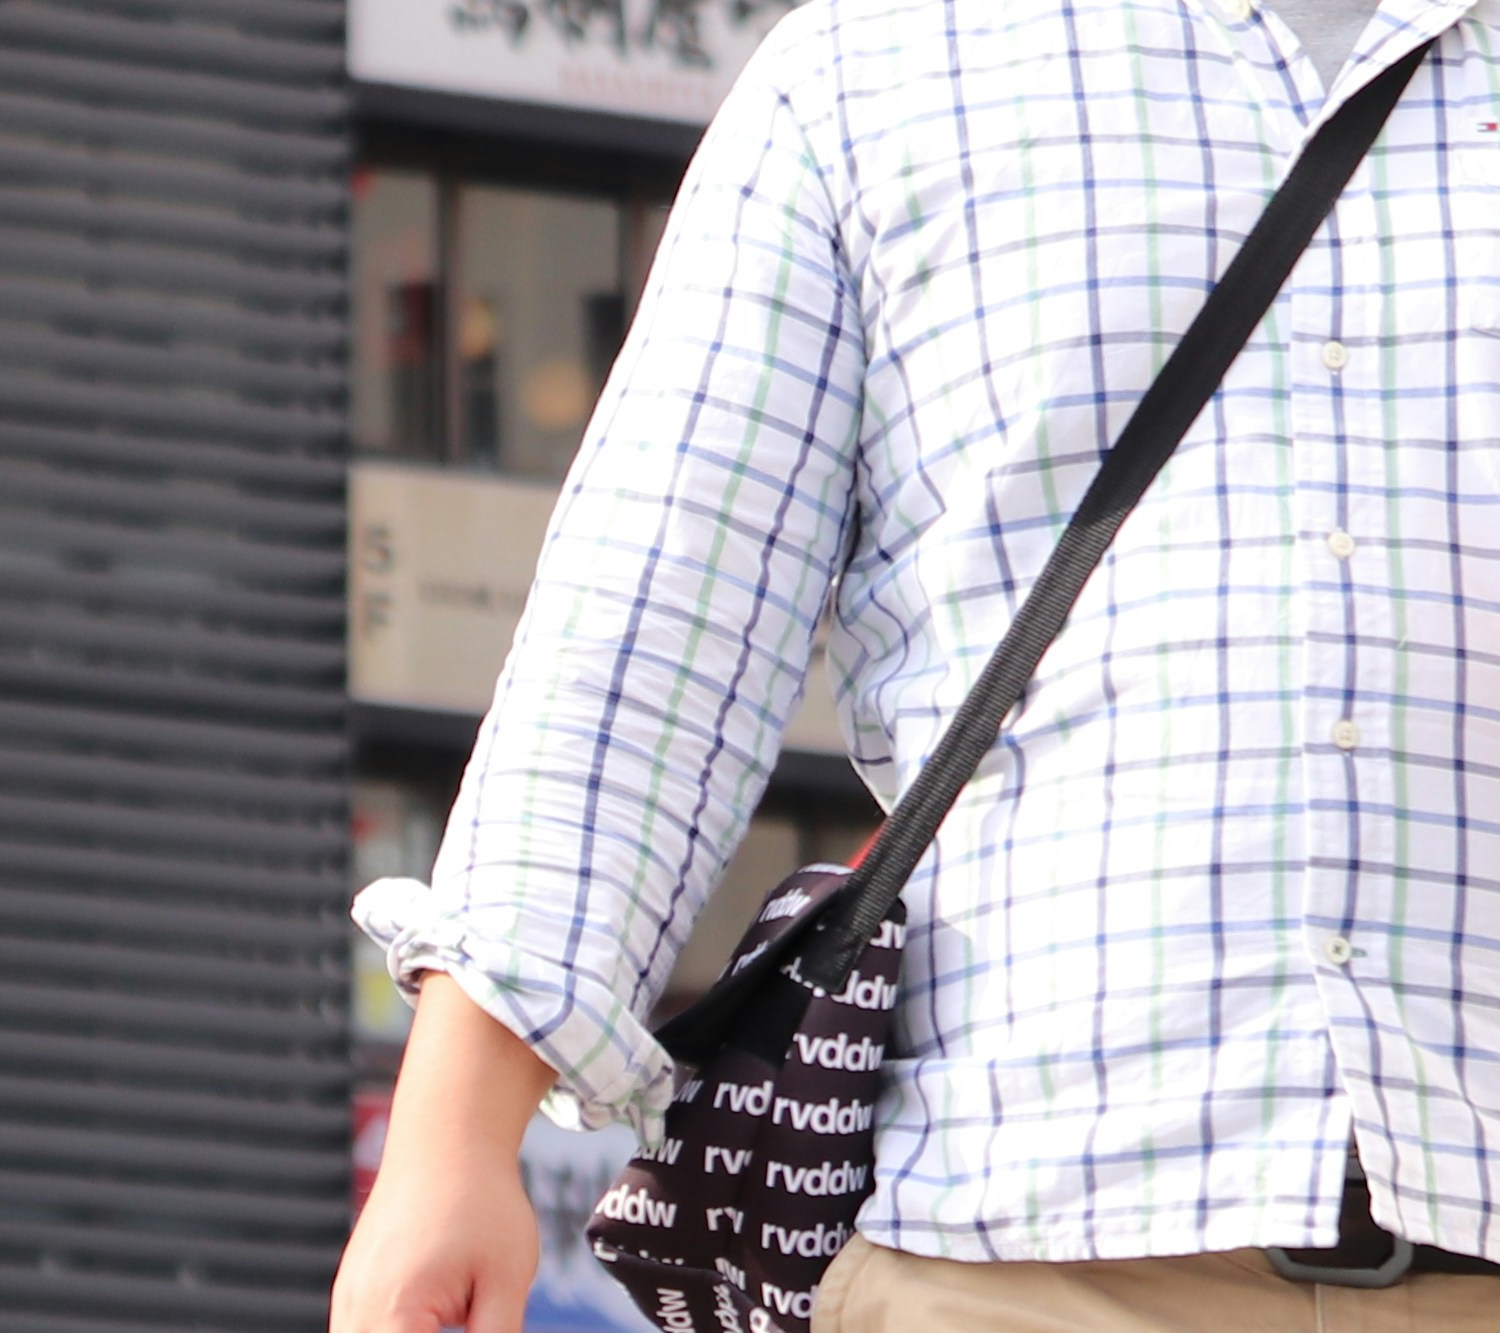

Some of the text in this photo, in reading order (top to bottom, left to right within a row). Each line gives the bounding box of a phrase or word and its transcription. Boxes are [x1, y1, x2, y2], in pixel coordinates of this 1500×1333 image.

[713, 1080, 774, 1116] rvd
[772, 1097, 873, 1134] rvddw
[766, 1160, 867, 1196] rvddw
[761, 1222, 852, 1257] rvdd
[762, 1282, 818, 1319] rvd
